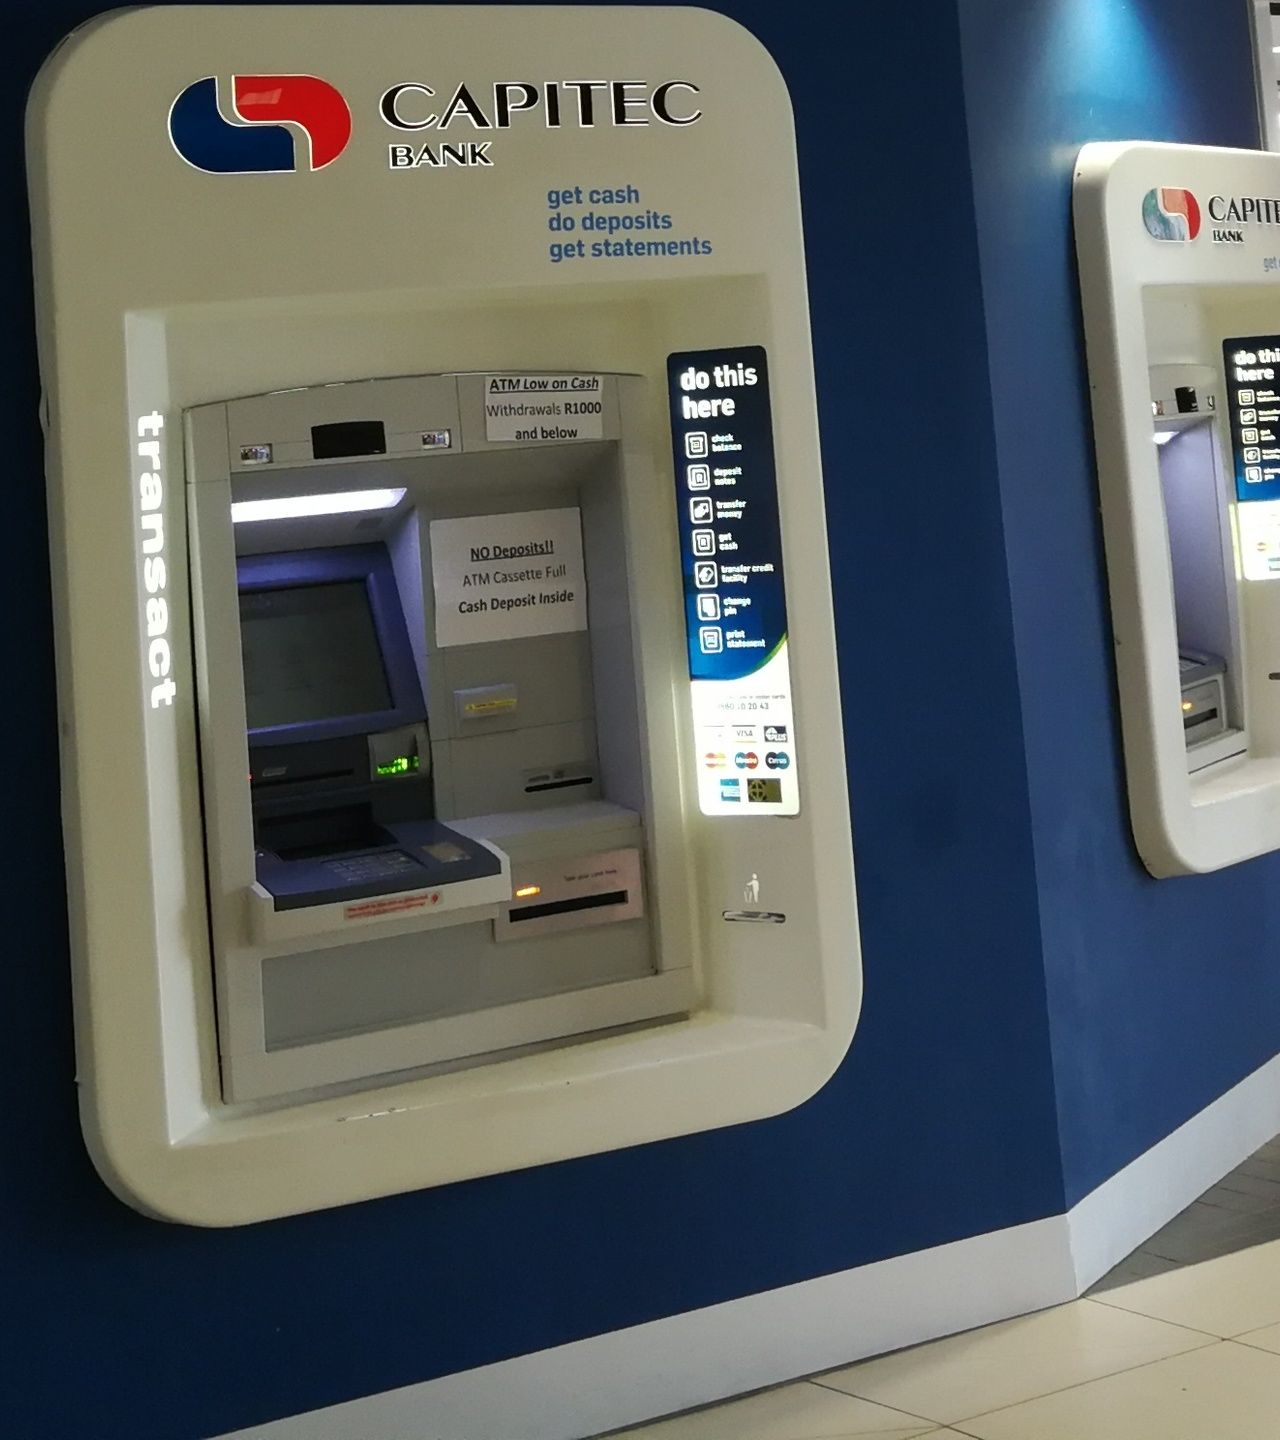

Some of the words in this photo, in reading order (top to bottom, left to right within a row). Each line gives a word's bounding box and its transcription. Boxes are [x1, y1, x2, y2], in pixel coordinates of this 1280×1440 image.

[379, 79, 703, 131] CAPITEC
[388, 141, 494, 170] BANK
[547, 186, 583, 211] get
[588, 184, 640, 205] cash
[548, 211, 576, 232] do
[581, 209, 673, 234] deposits
[549, 239, 586, 262] get
[591, 234, 713, 258] statements
[1212, 230, 1244, 243] BANK
[1235, 350, 1257, 365] do
[489, 378, 521, 391] ATM
[524, 378, 549, 390] Low
[552, 380, 567, 390] on
[571, 376, 599, 389] Cash
[680, 367, 710, 390] do
[713, 363, 758, 387] this
[1236, 366, 1274, 382] here
[486, 403, 562, 417] Withdrawals
[564, 401, 602, 415] R1000
[682, 396, 735, 419] here
[515, 428, 537, 440] and
[541, 426, 578, 440] below
[137, 410, 176, 709] transact
[470, 547, 490, 560] NO
[493, 540, 554, 558] Deposits!!
[463, 574, 490, 587] ATM
[493, 568, 542, 584] Cassette
[545, 564, 566, 578] Full
[458, 601, 488, 614] Cash
[490, 594, 536, 611] Deposit
[539, 589, 574, 604] Inside
